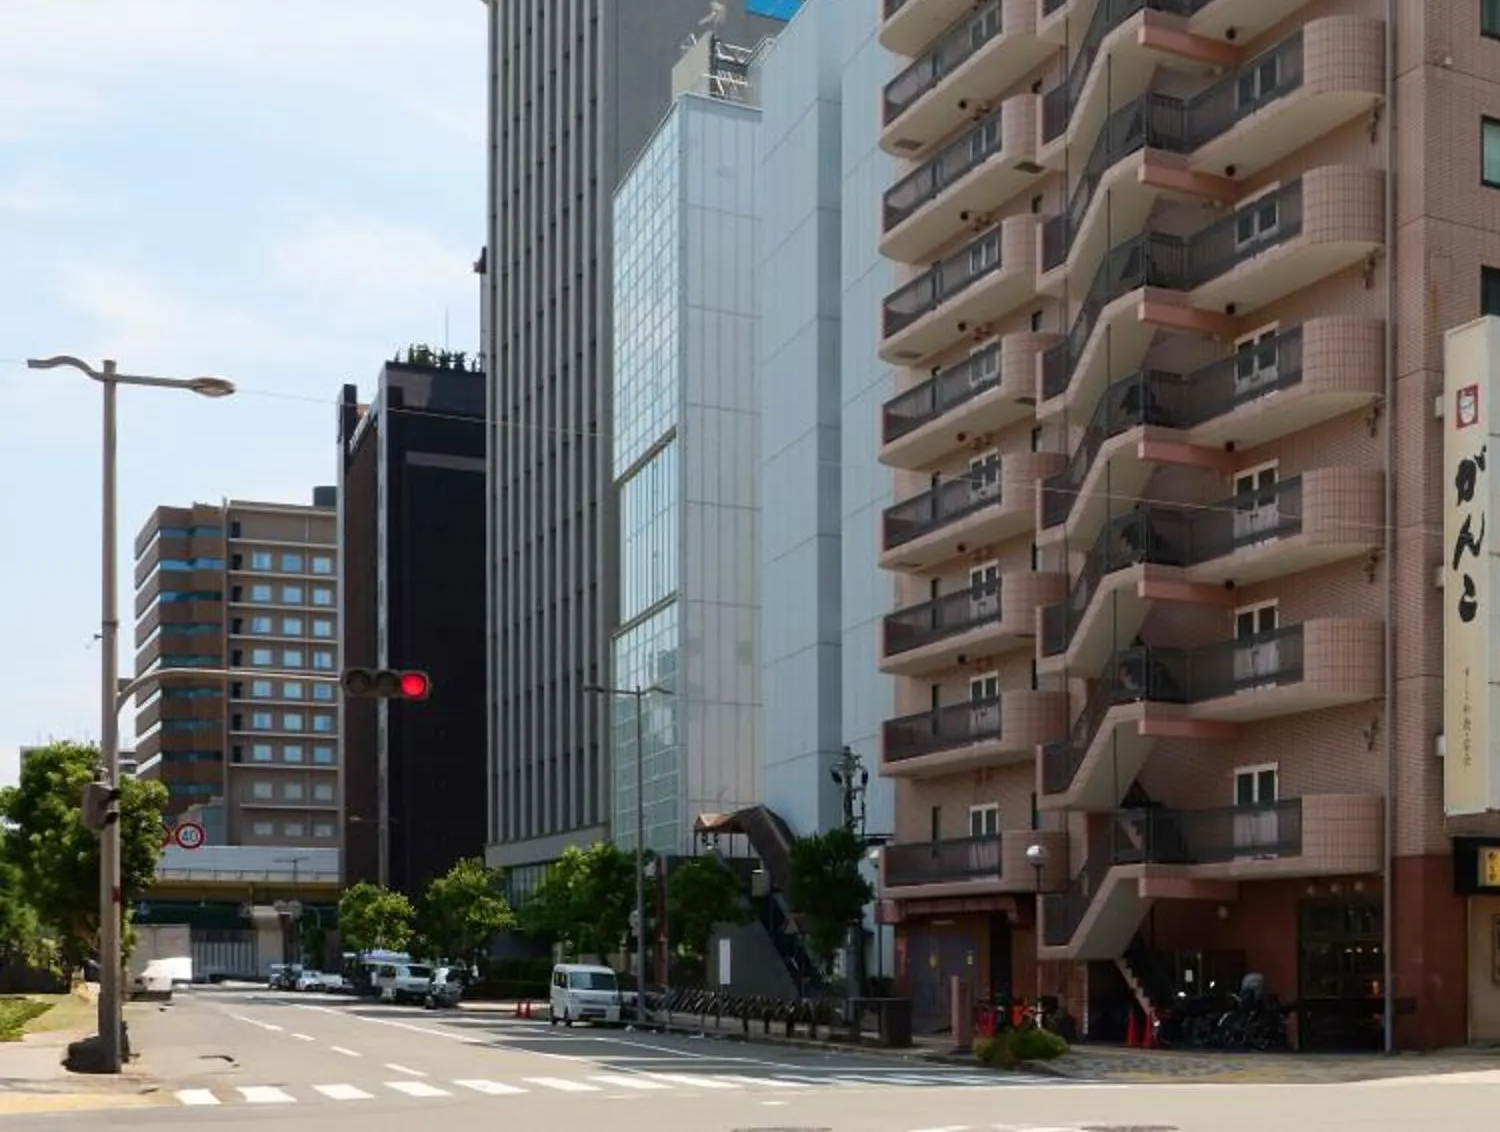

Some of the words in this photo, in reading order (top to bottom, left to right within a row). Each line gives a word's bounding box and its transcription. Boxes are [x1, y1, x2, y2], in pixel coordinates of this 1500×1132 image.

[1454, 444, 1488, 623] がんこ
[182, 829, 197, 842] 40
